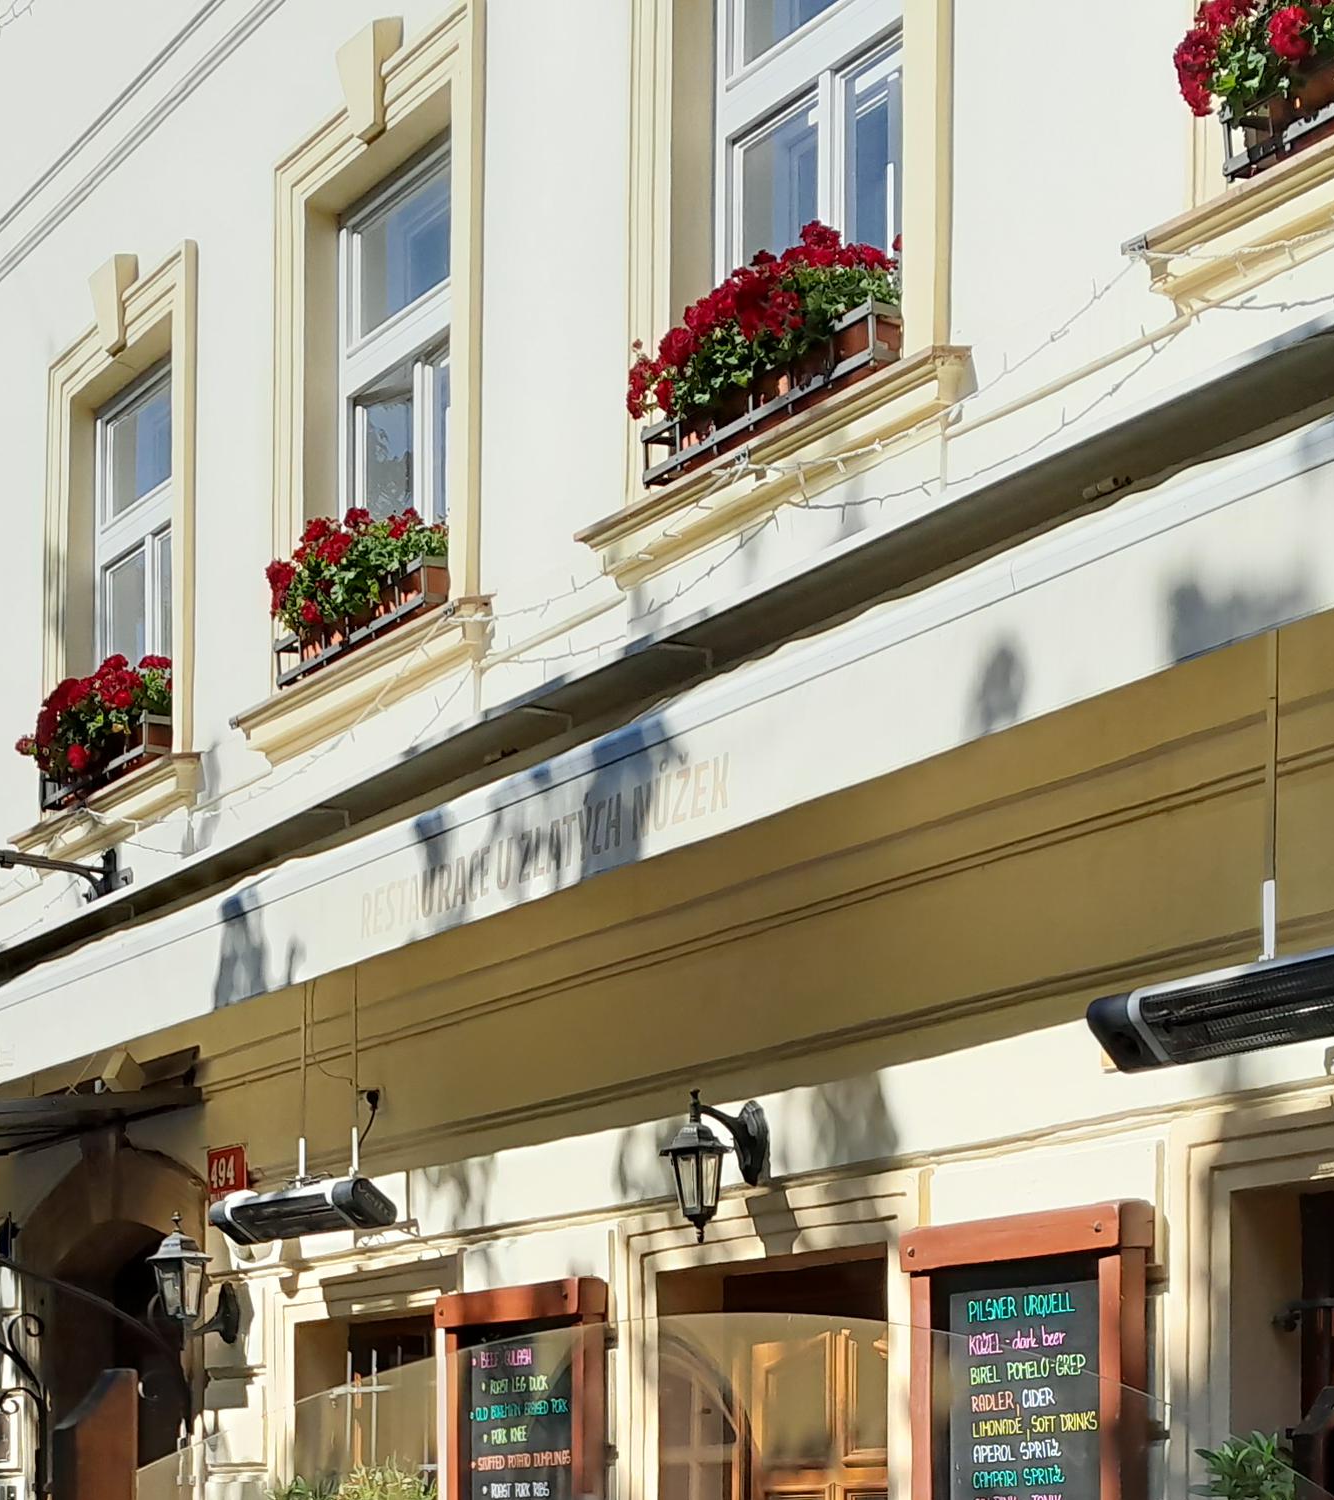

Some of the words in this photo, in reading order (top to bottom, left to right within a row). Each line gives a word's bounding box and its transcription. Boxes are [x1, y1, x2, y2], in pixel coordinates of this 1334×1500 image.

[361, 846, 490, 936] RESTAURACE
[496, 840, 513, 890] U
[519, 792, 621, 883] ZLATÝCH
[632, 751, 731, 840] NŮŽEK
[210, 1155, 235, 1188] 494
[968, 1297, 1017, 1322] PILSNER
[1023, 1292, 1075, 1317] URQUELL
[969, 1333, 1003, 1355] KOZEL
[1012, 1328, 1039, 1349] dark
[1041, 1325, 1066, 1346] beer
[512, 1376, 526, 1392] LEG
[970, 1365, 1001, 1385] BIREL
[1022, 1387, 1055, 1408] CIDER
[510, 1426, 527, 1442] KNEE
[1031, 1415, 1056, 1433] SOFT
[1060, 1411, 1098, 1431] DRINKS
[973, 1445, 1016, 1463] APEROL
[1020, 1438, 1062, 1460] SPRITZ
[972, 1471, 1017, 1489] CAMPARI
[1023, 1465, 1065, 1486] SPRITZ
